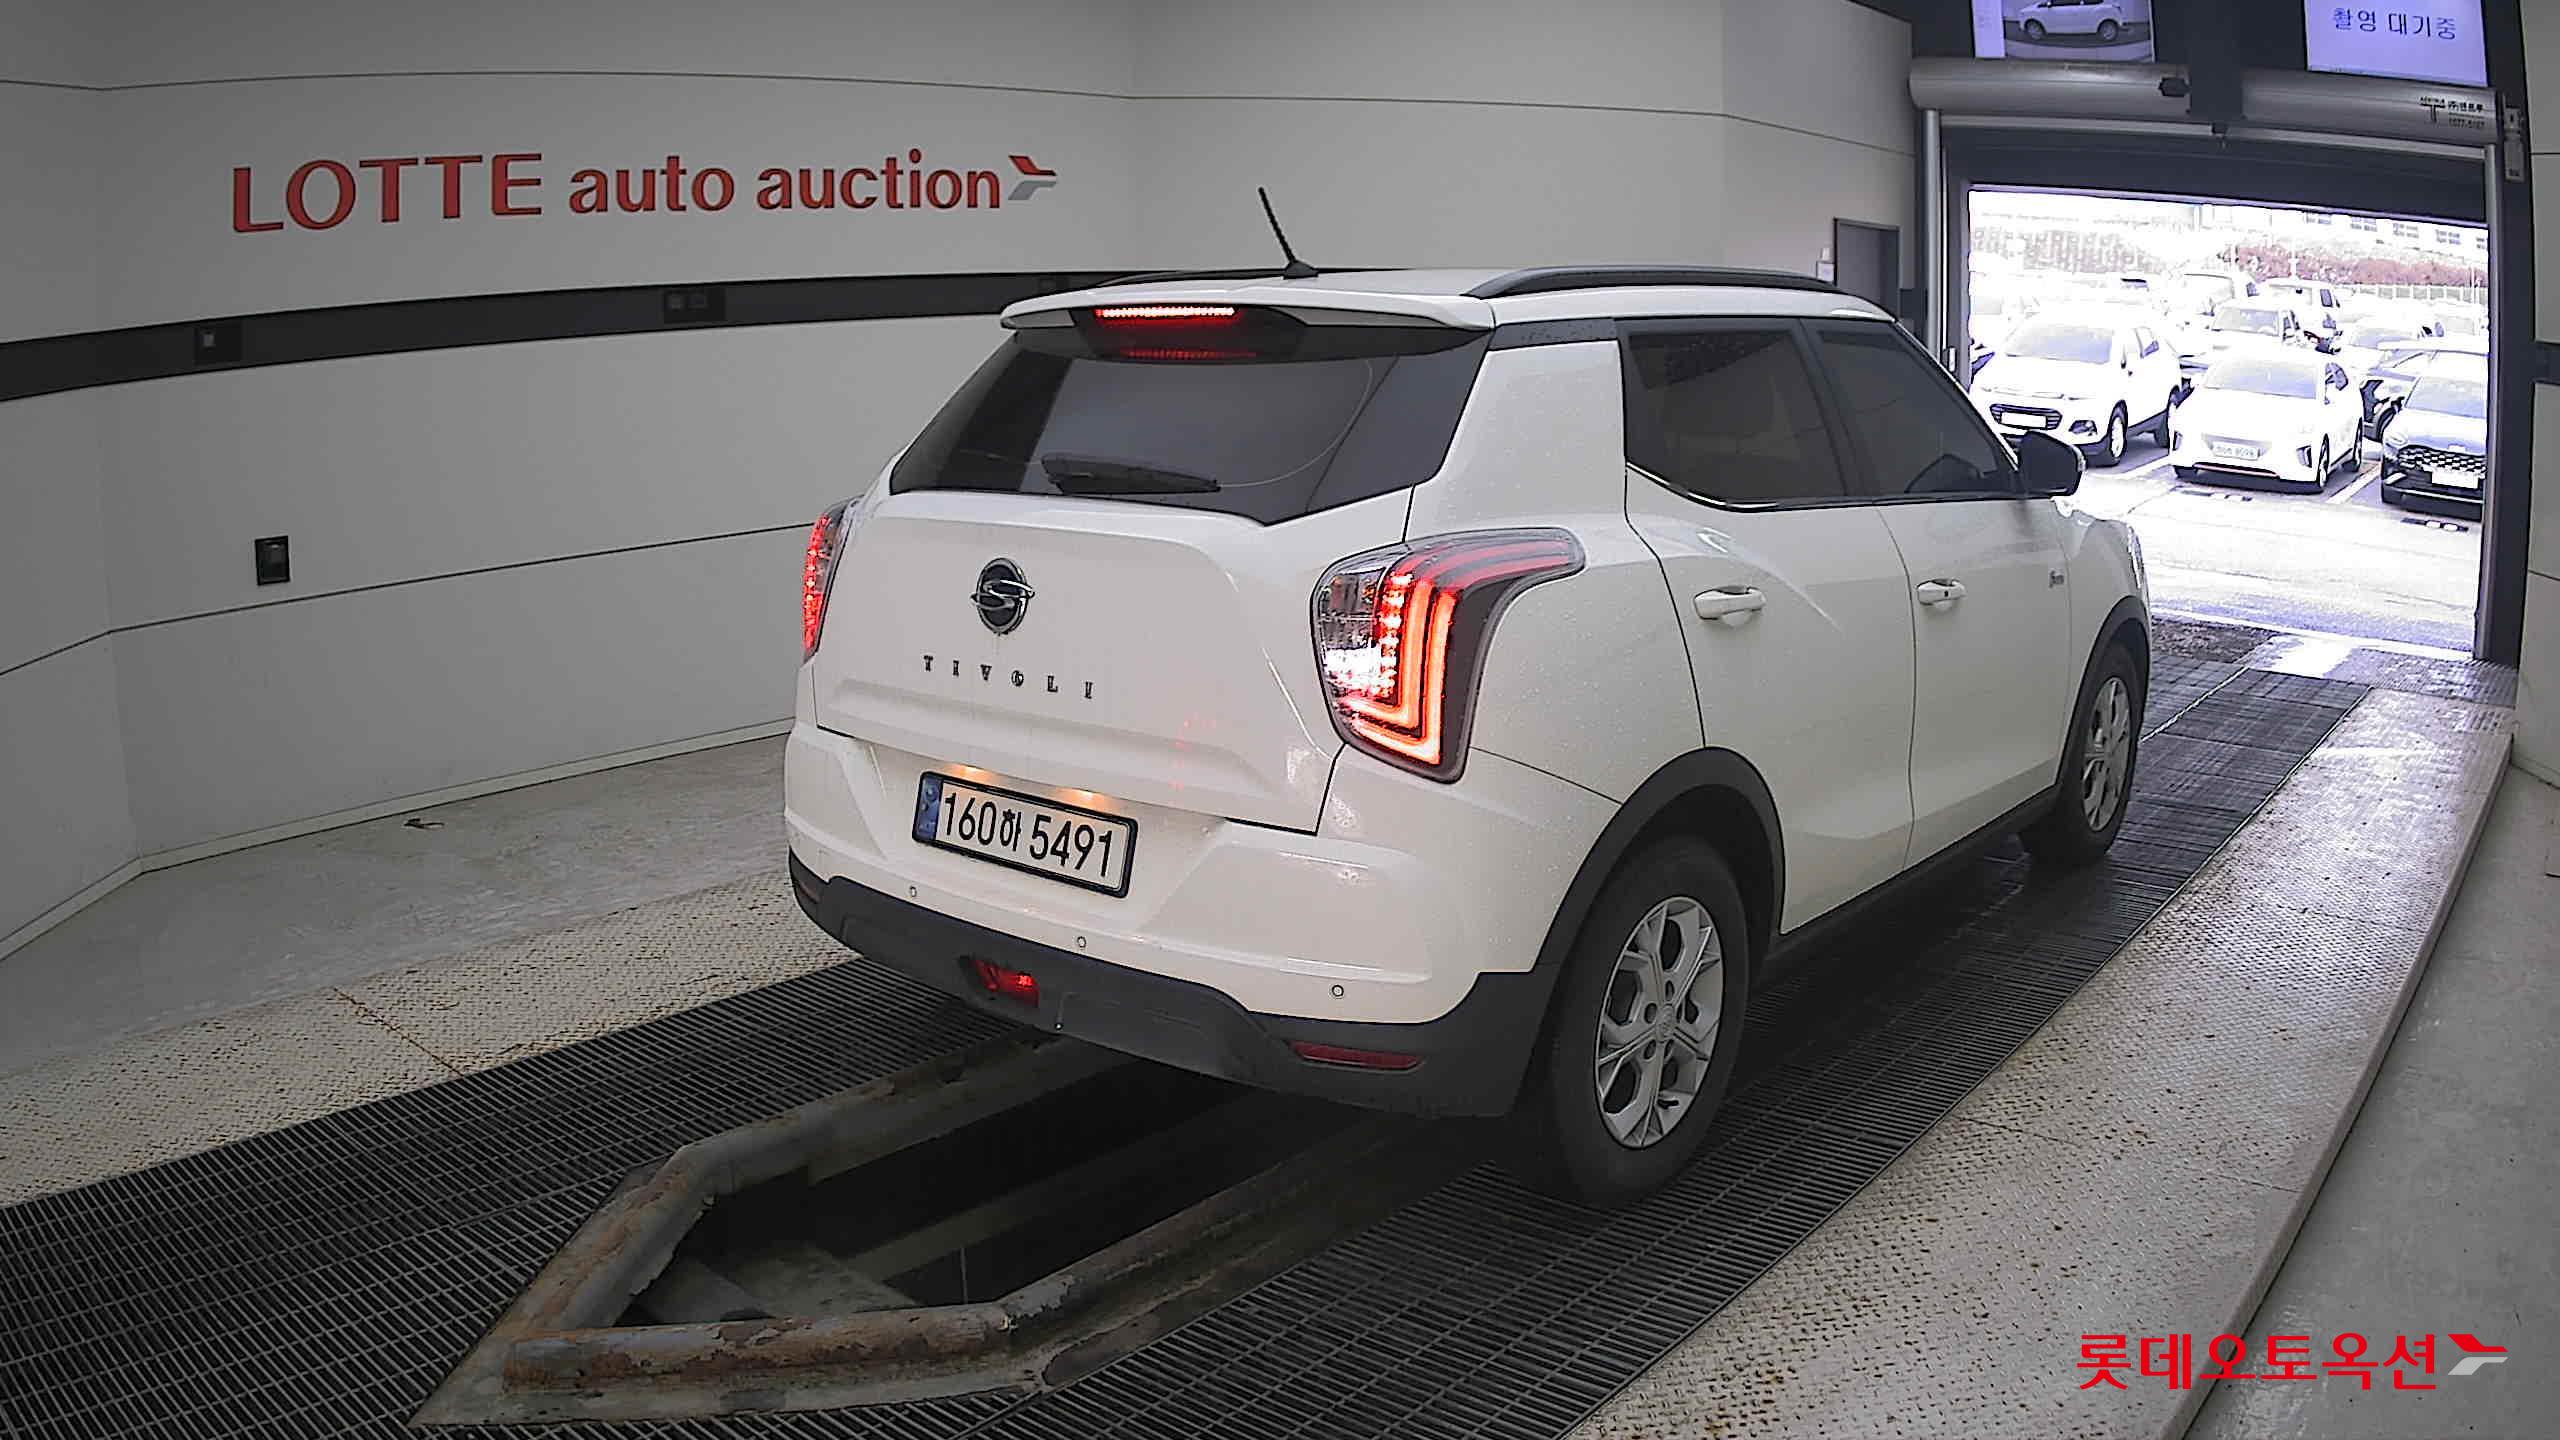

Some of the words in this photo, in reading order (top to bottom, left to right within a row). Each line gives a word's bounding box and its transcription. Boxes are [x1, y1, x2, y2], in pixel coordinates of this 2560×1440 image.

[2333, 7, 2377, 33] 촬영
[2388, 12, 2457, 41] 대기중
[233, 153, 542, 233] LOTTE
[569, 154, 736, 214] auto
[756, 148, 1001, 210] auction
[923, 655, 1094, 700] TIVOLI
[944, 792, 1022, 852] 160하
[1029, 814, 1113, 878] 5491
